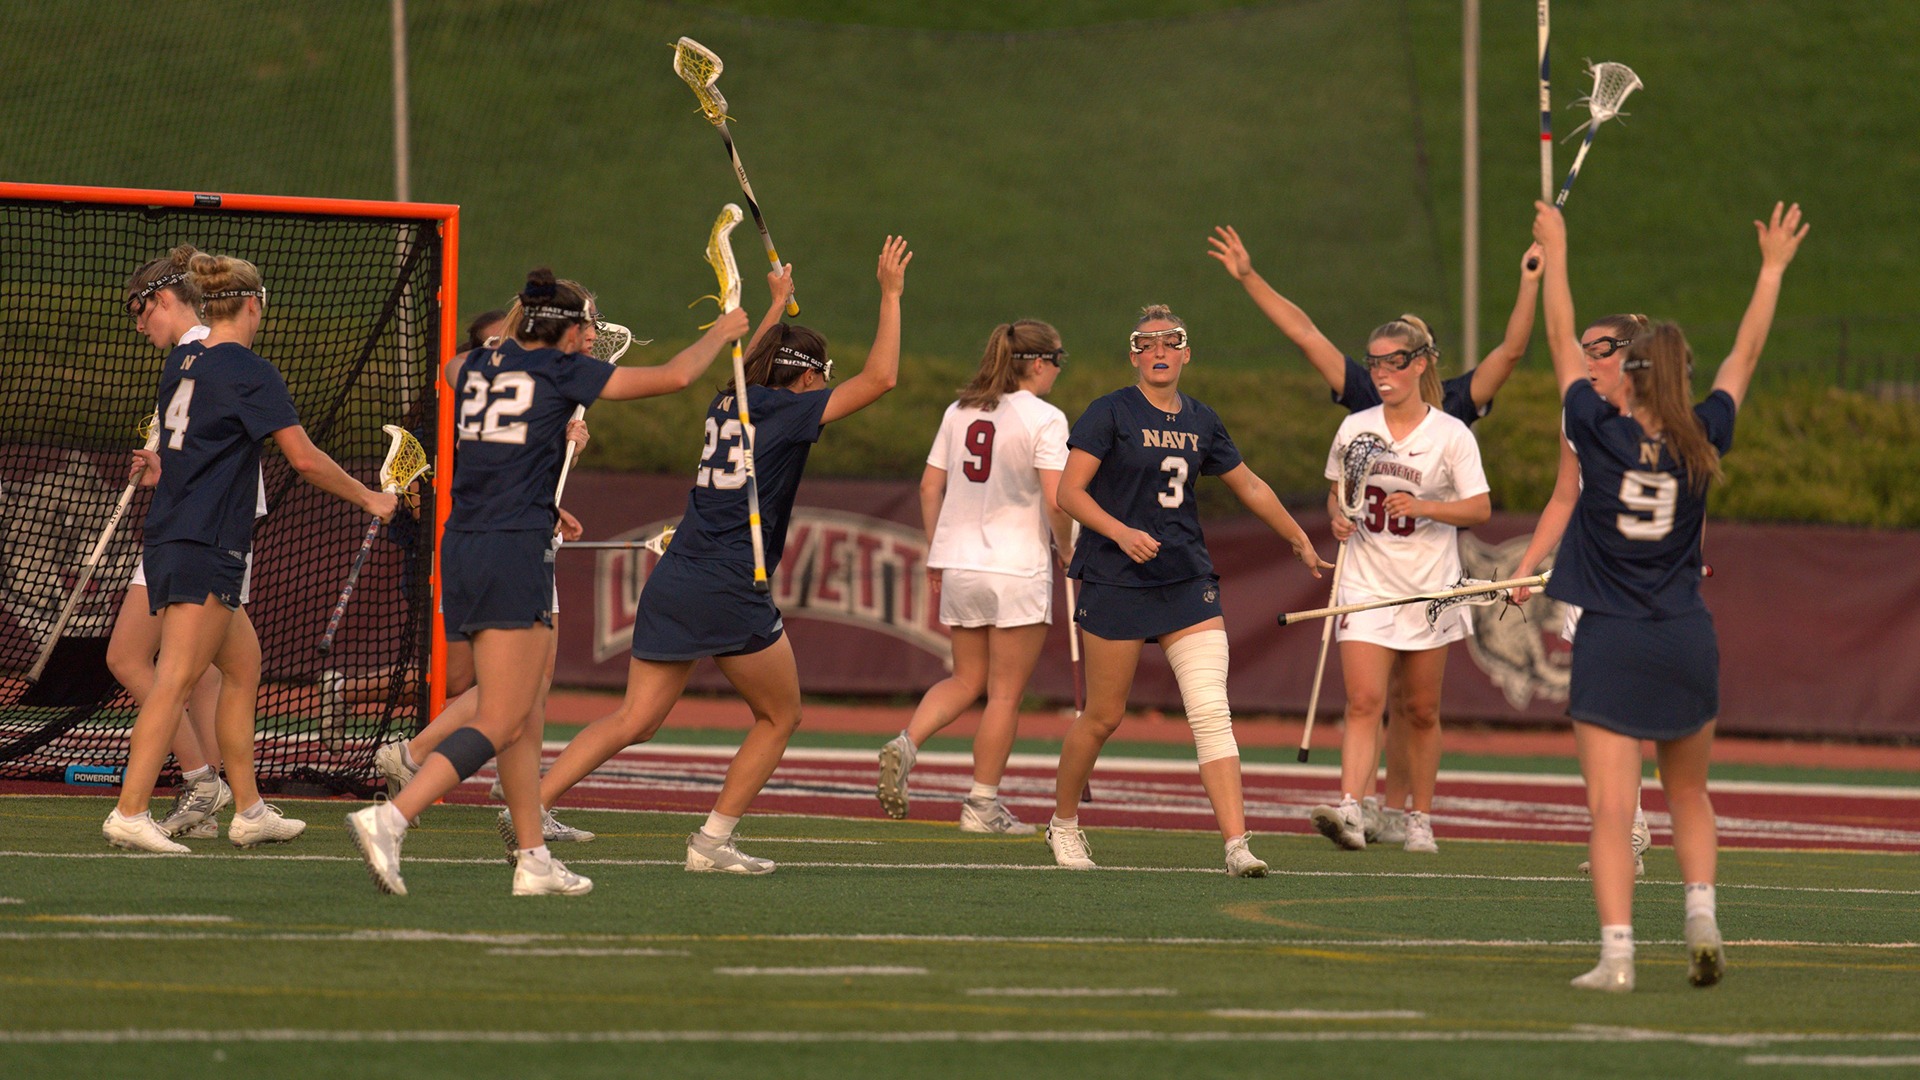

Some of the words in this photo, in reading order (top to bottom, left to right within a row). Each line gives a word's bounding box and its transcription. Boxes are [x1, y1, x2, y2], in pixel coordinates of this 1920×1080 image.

[180, 354, 197, 371] N
[780, 346, 793, 354] AIT
[794, 351, 810, 361] GAIT
[810, 358, 824, 368] GAIT
[164, 377, 196, 451] 4
[457, 371, 536, 445] 22
[717, 395, 735, 413] N
[696, 417, 756, 490] 23
[963, 419, 996, 484] 9
[1141, 429, 1200, 453] NAVY
[1638, 441, 1660, 468] N
[1157, 455, 1189, 509] 3
[1616, 469, 1679, 541] 9
[74, 773, 121, 783] POWERADE
